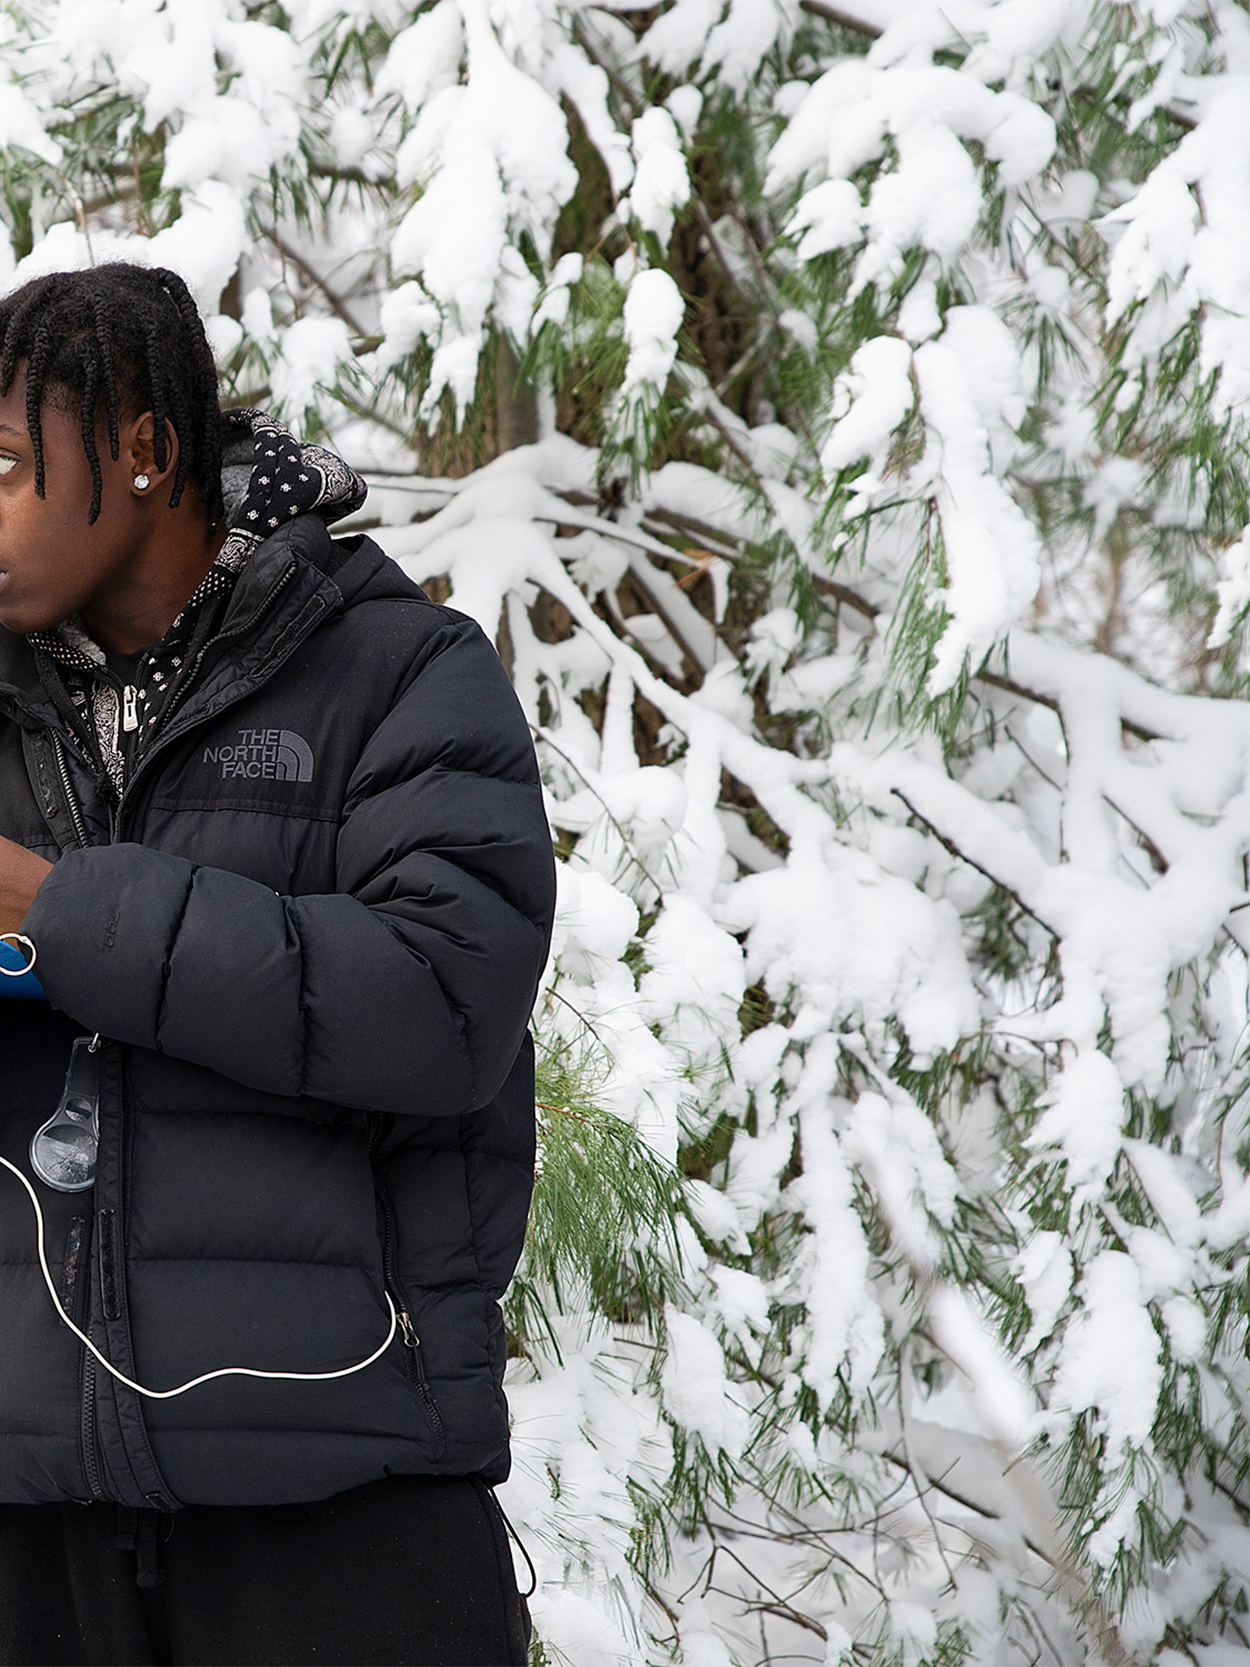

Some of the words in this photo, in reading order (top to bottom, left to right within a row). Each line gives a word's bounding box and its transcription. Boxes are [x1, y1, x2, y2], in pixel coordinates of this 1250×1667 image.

[238, 729, 280, 745] THE
[203, 745, 277, 763] NORTH
[221, 761, 276, 779] FACE
